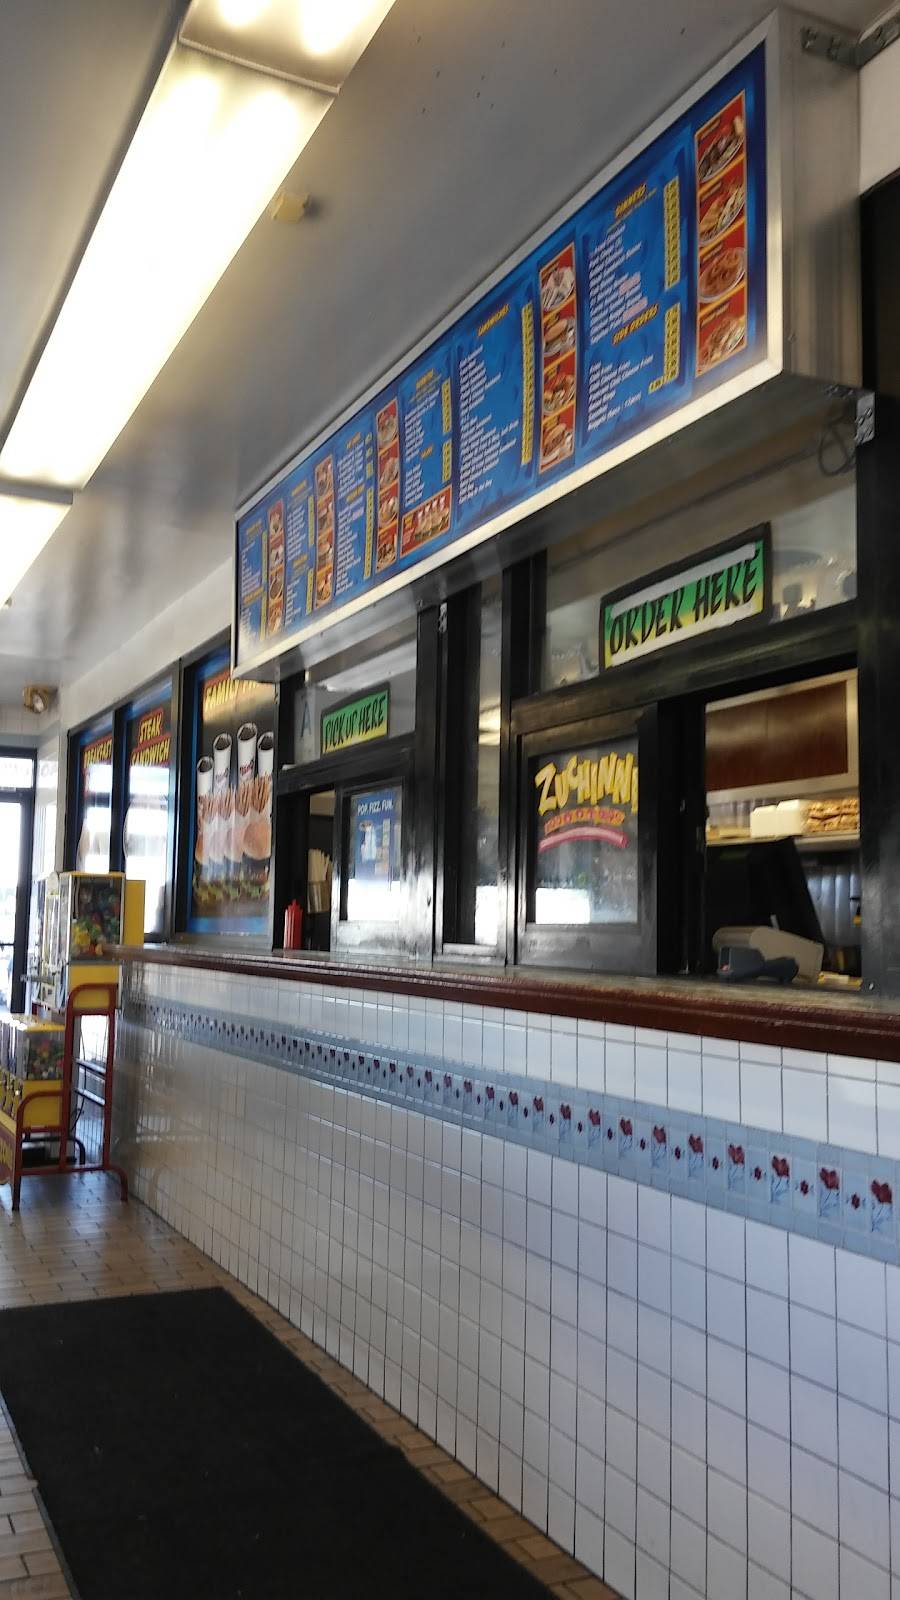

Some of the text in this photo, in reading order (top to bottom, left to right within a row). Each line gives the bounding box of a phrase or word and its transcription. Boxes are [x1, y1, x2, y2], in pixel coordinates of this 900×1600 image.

[609, 548, 761, 656] ORDER HERE
[140, 713, 162, 744] STEAK
[324, 695, 387, 751] PICK UP HERE
[131, 738, 170, 767] SANDWICH
